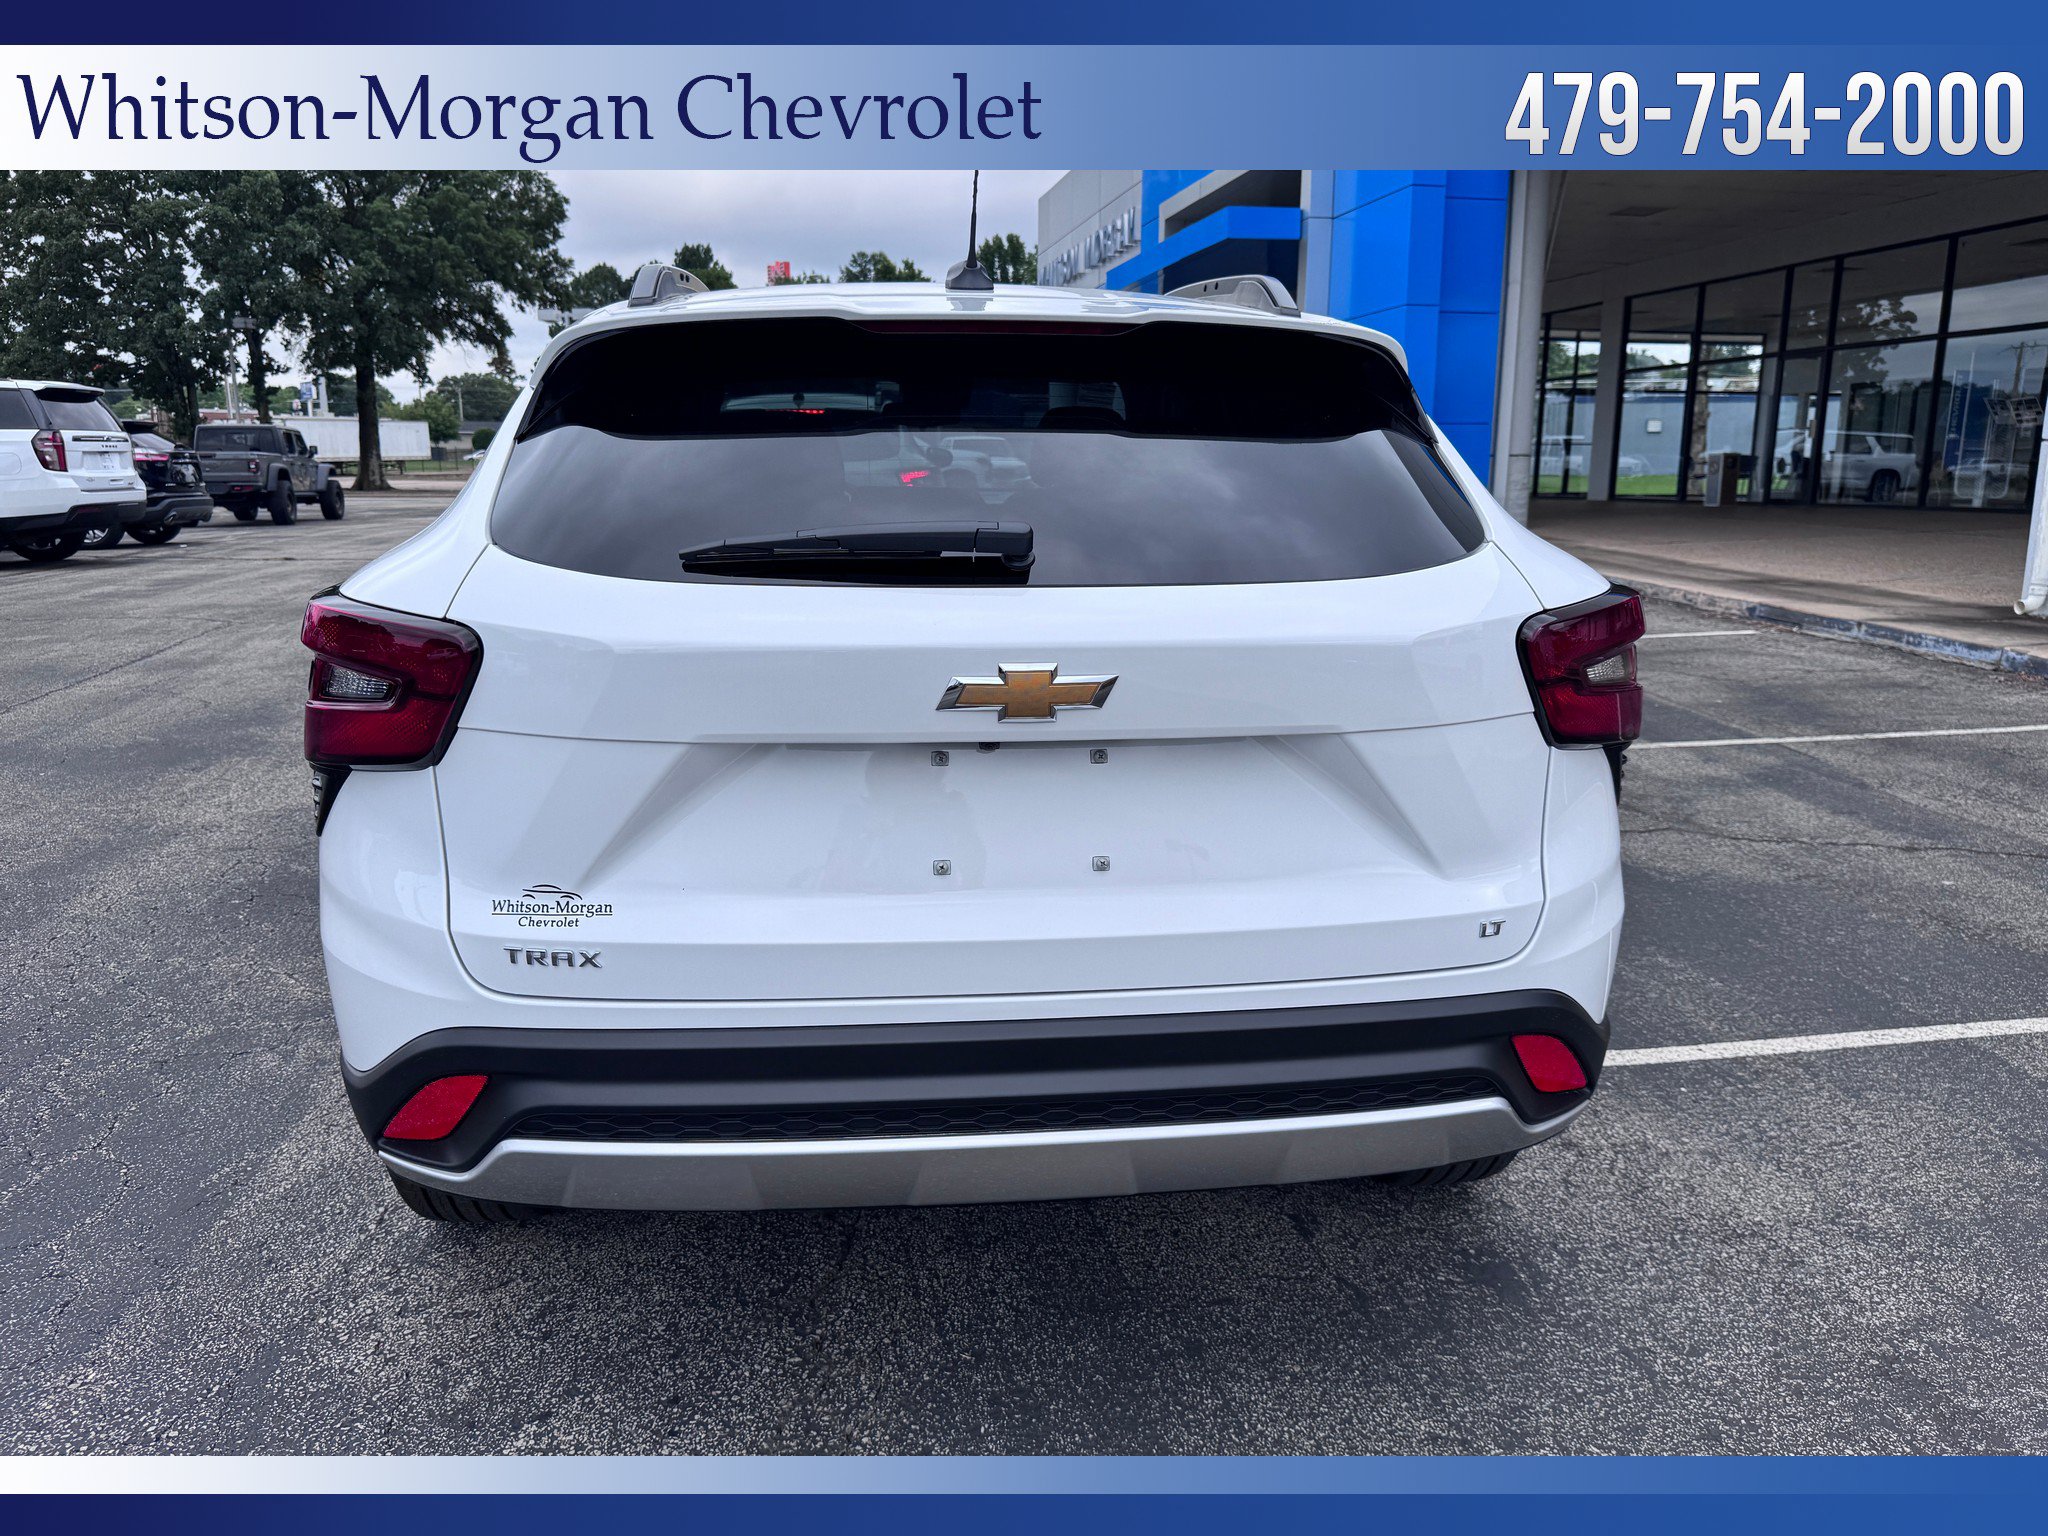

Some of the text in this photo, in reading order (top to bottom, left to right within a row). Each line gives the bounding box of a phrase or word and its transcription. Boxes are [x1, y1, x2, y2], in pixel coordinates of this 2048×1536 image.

[491, 899, 613, 918] Whitson-Morgan
[518, 916, 580, 928] Chevrolet
[1479, 919, 1506, 938] LT
[503, 945, 602, 968] TRAX
